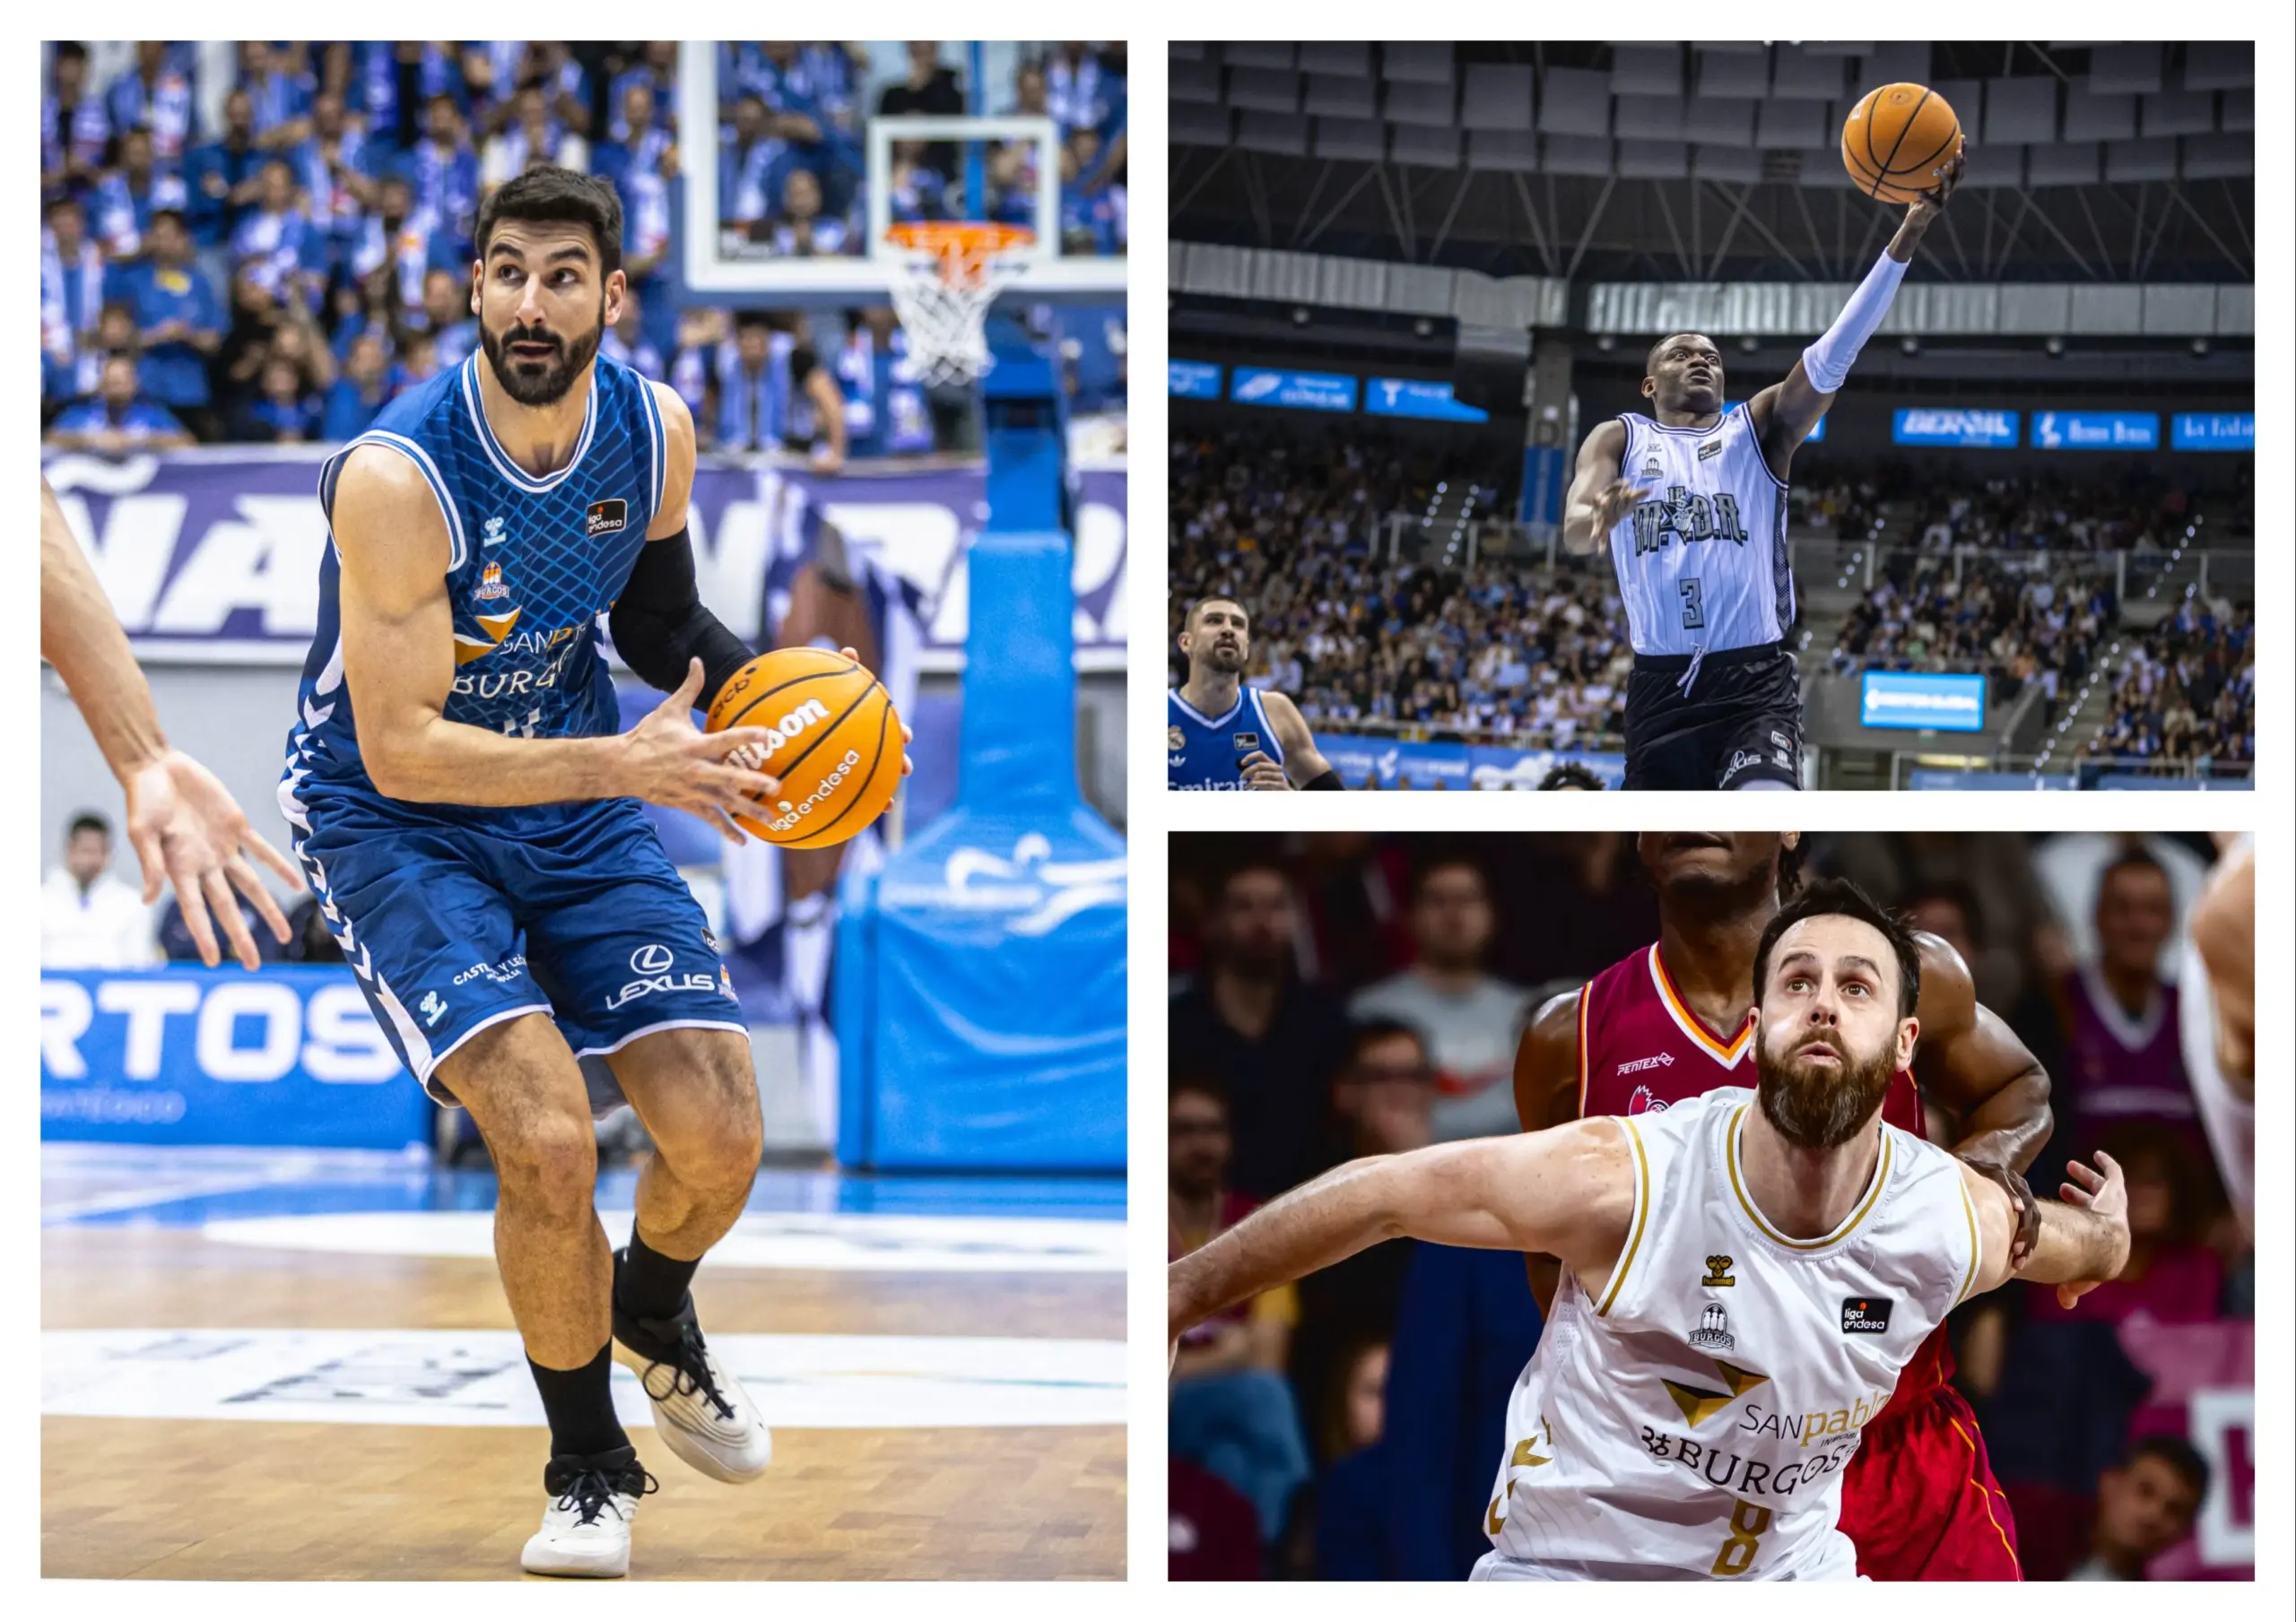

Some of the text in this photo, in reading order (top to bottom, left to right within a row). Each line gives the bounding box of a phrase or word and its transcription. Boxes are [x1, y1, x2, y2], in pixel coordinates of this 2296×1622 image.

[1679, 577, 1704, 629] 3
[797, 750, 860, 814] endesa
[605, 974, 715, 1010] LEXUS
[1617, 1056, 1659, 1076] PENTEX
[1703, 1276, 1734, 1285] hummel
[1844, 1308, 1864, 1320] liga
[1844, 1319, 1884, 1329] endesa
[1693, 1332, 1731, 1346] BURGOS
[1675, 1437, 1848, 1496] BURGOS
[1710, 1497, 1772, 1575] 8
